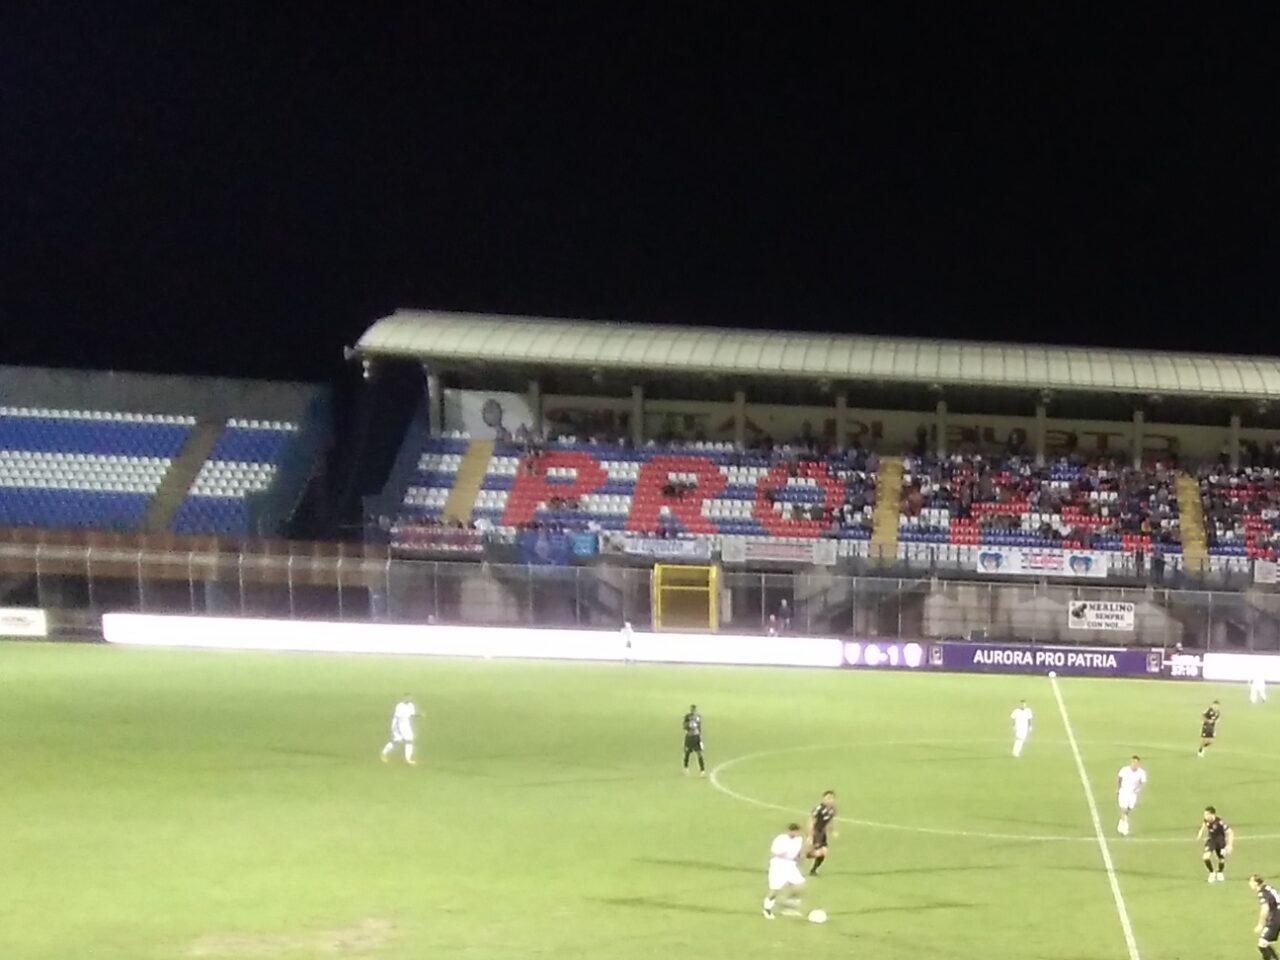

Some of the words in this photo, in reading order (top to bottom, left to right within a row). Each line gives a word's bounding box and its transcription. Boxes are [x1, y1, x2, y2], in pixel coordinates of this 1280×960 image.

[500, 451, 847, 537] PRO
[1089, 603, 1133, 612] MERLINO
[1095, 613, 1125, 621] SEMPRE
[973, 650, 1033, 665] AURORA
[1036, 652, 1065, 666] PRO
[1067, 653, 1117, 668] PATRIA
